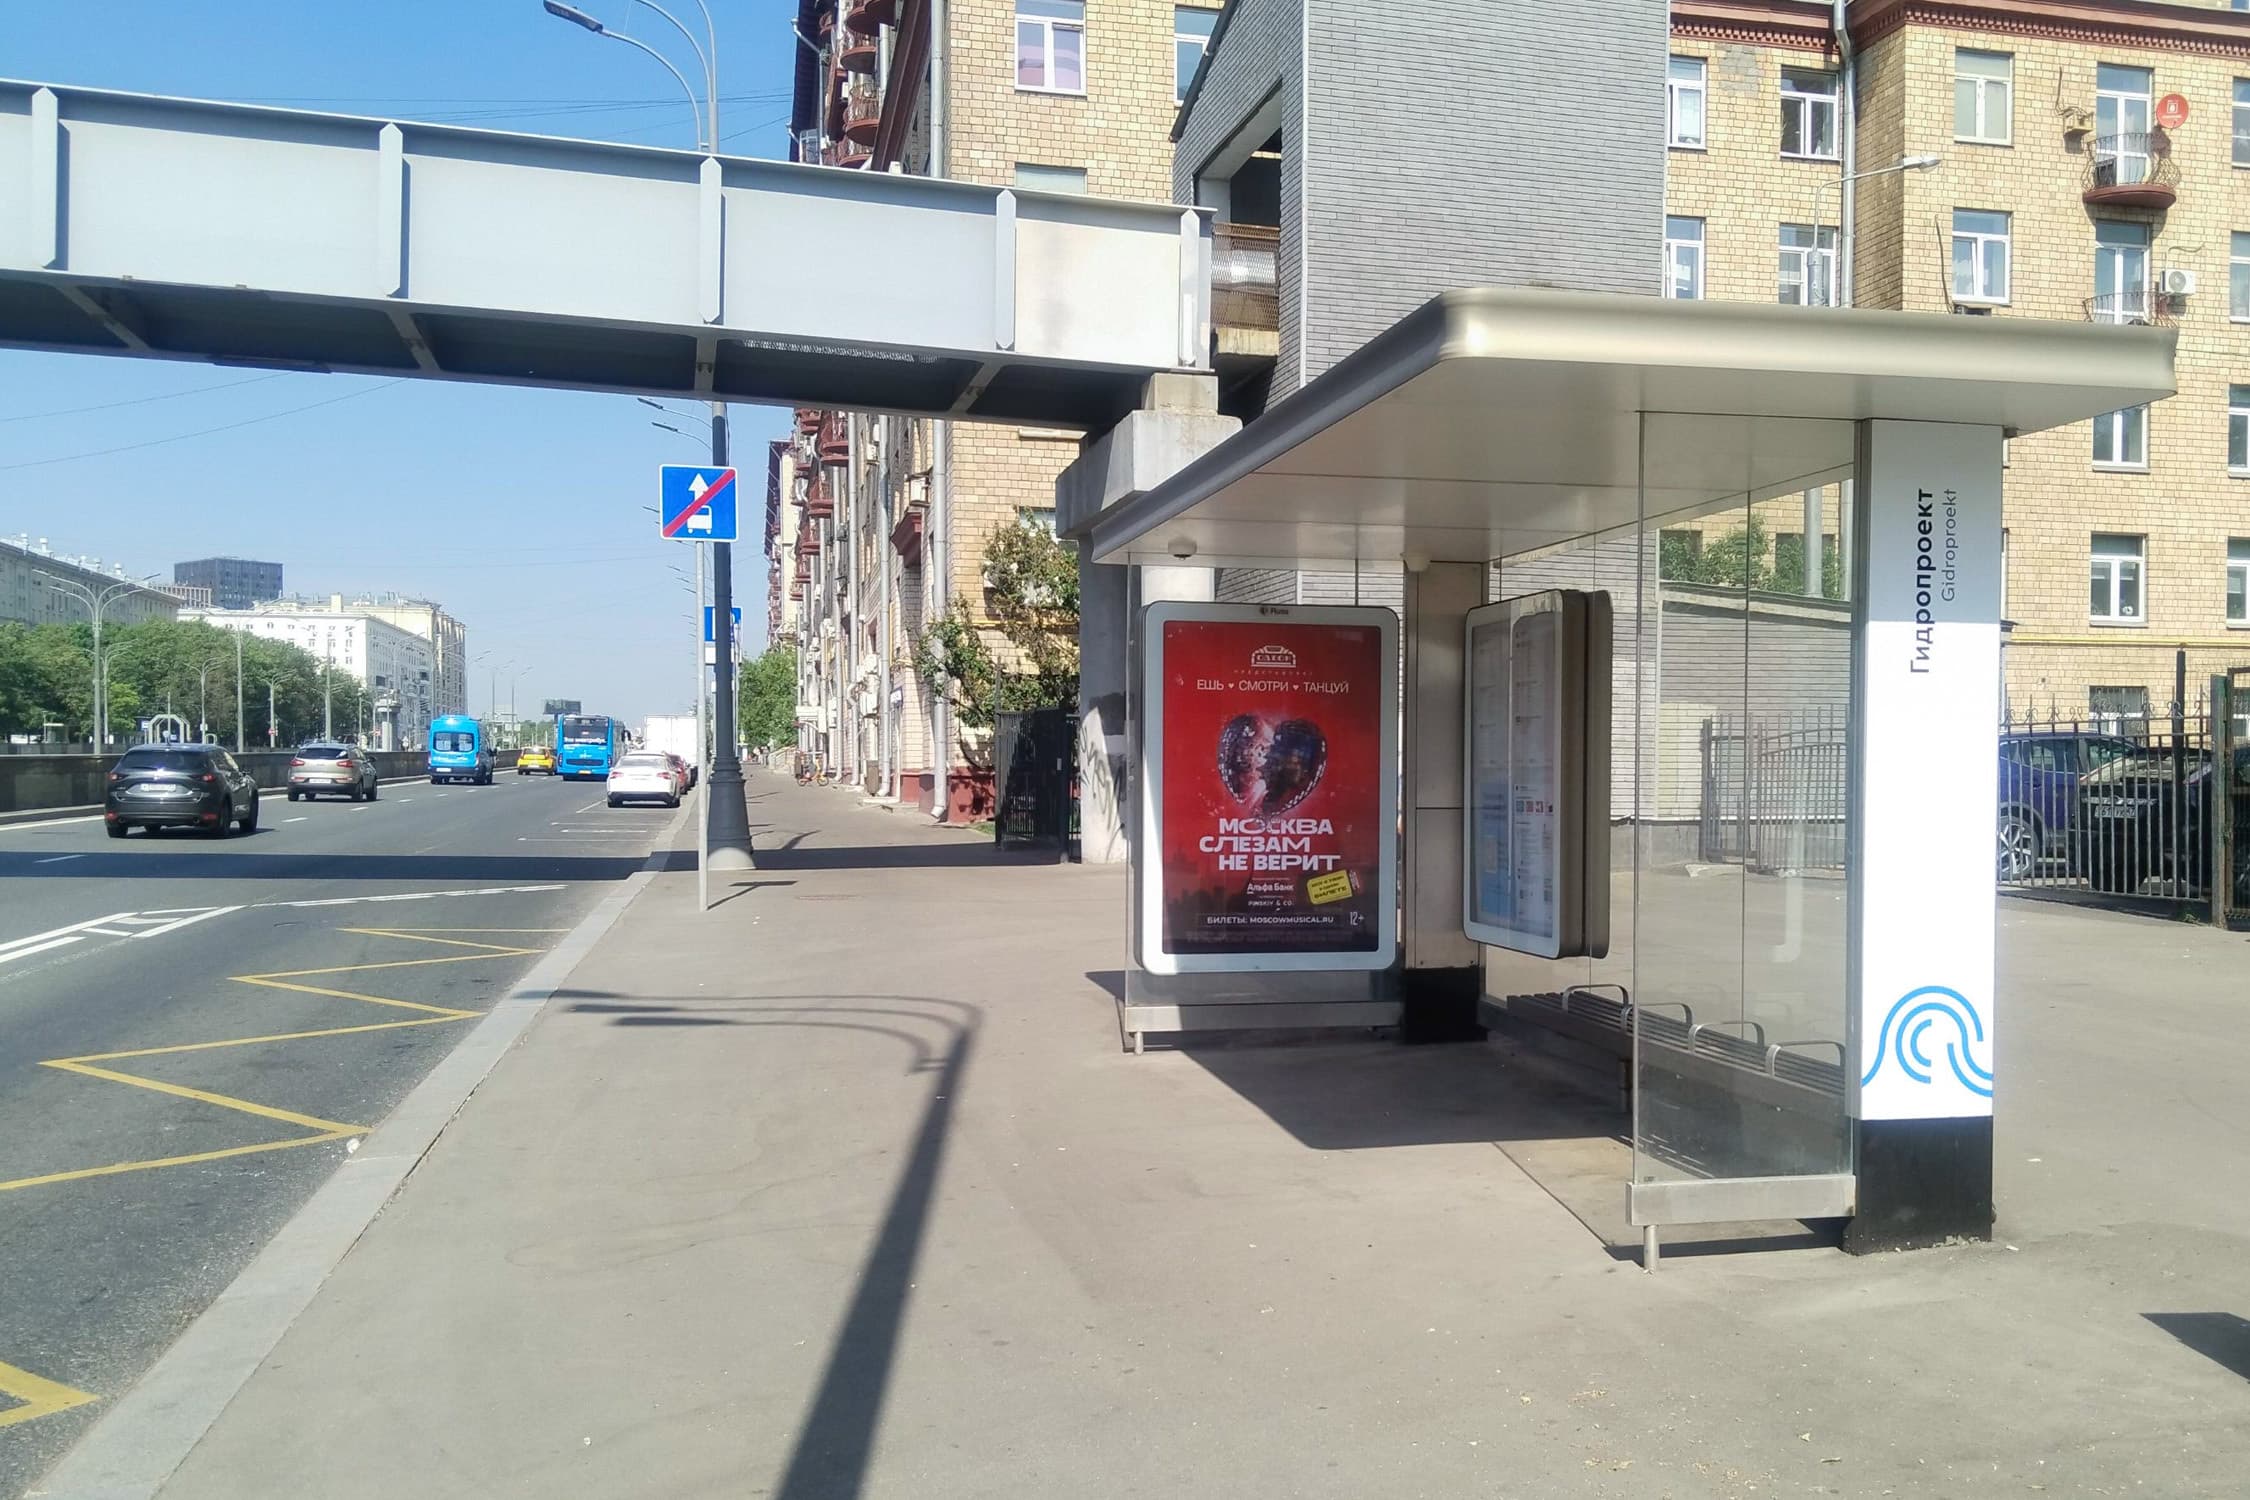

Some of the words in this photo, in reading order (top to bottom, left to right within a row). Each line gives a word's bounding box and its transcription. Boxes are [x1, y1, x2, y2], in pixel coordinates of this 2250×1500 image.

[1942, 489, 1959, 602] Gidroproekt
[1910, 488, 1937, 674] Гидропроект
[1197, 679, 1224, 691] ЕШЬ
[1238, 680, 1289, 692] СМОТРИ
[1304, 680, 1349, 694] ТАНЦУЙ
[1219, 818, 1334, 835] МОСКВА
[1199, 836, 1310, 853] СЛЕЗАМ
[1219, 855, 1249, 871] НЕ
[1253, 854, 1341, 871] ВЕРИТ
[1246, 882, 1273, 893] Альфа
[1273, 882, 1294, 891] Банк
[1207, 916, 1248, 925] БИЛЕТЫ:
[1250, 916, 1334, 925] MOSCOWMUSICAL.RU
[1350, 911, 1365, 926] 12+
